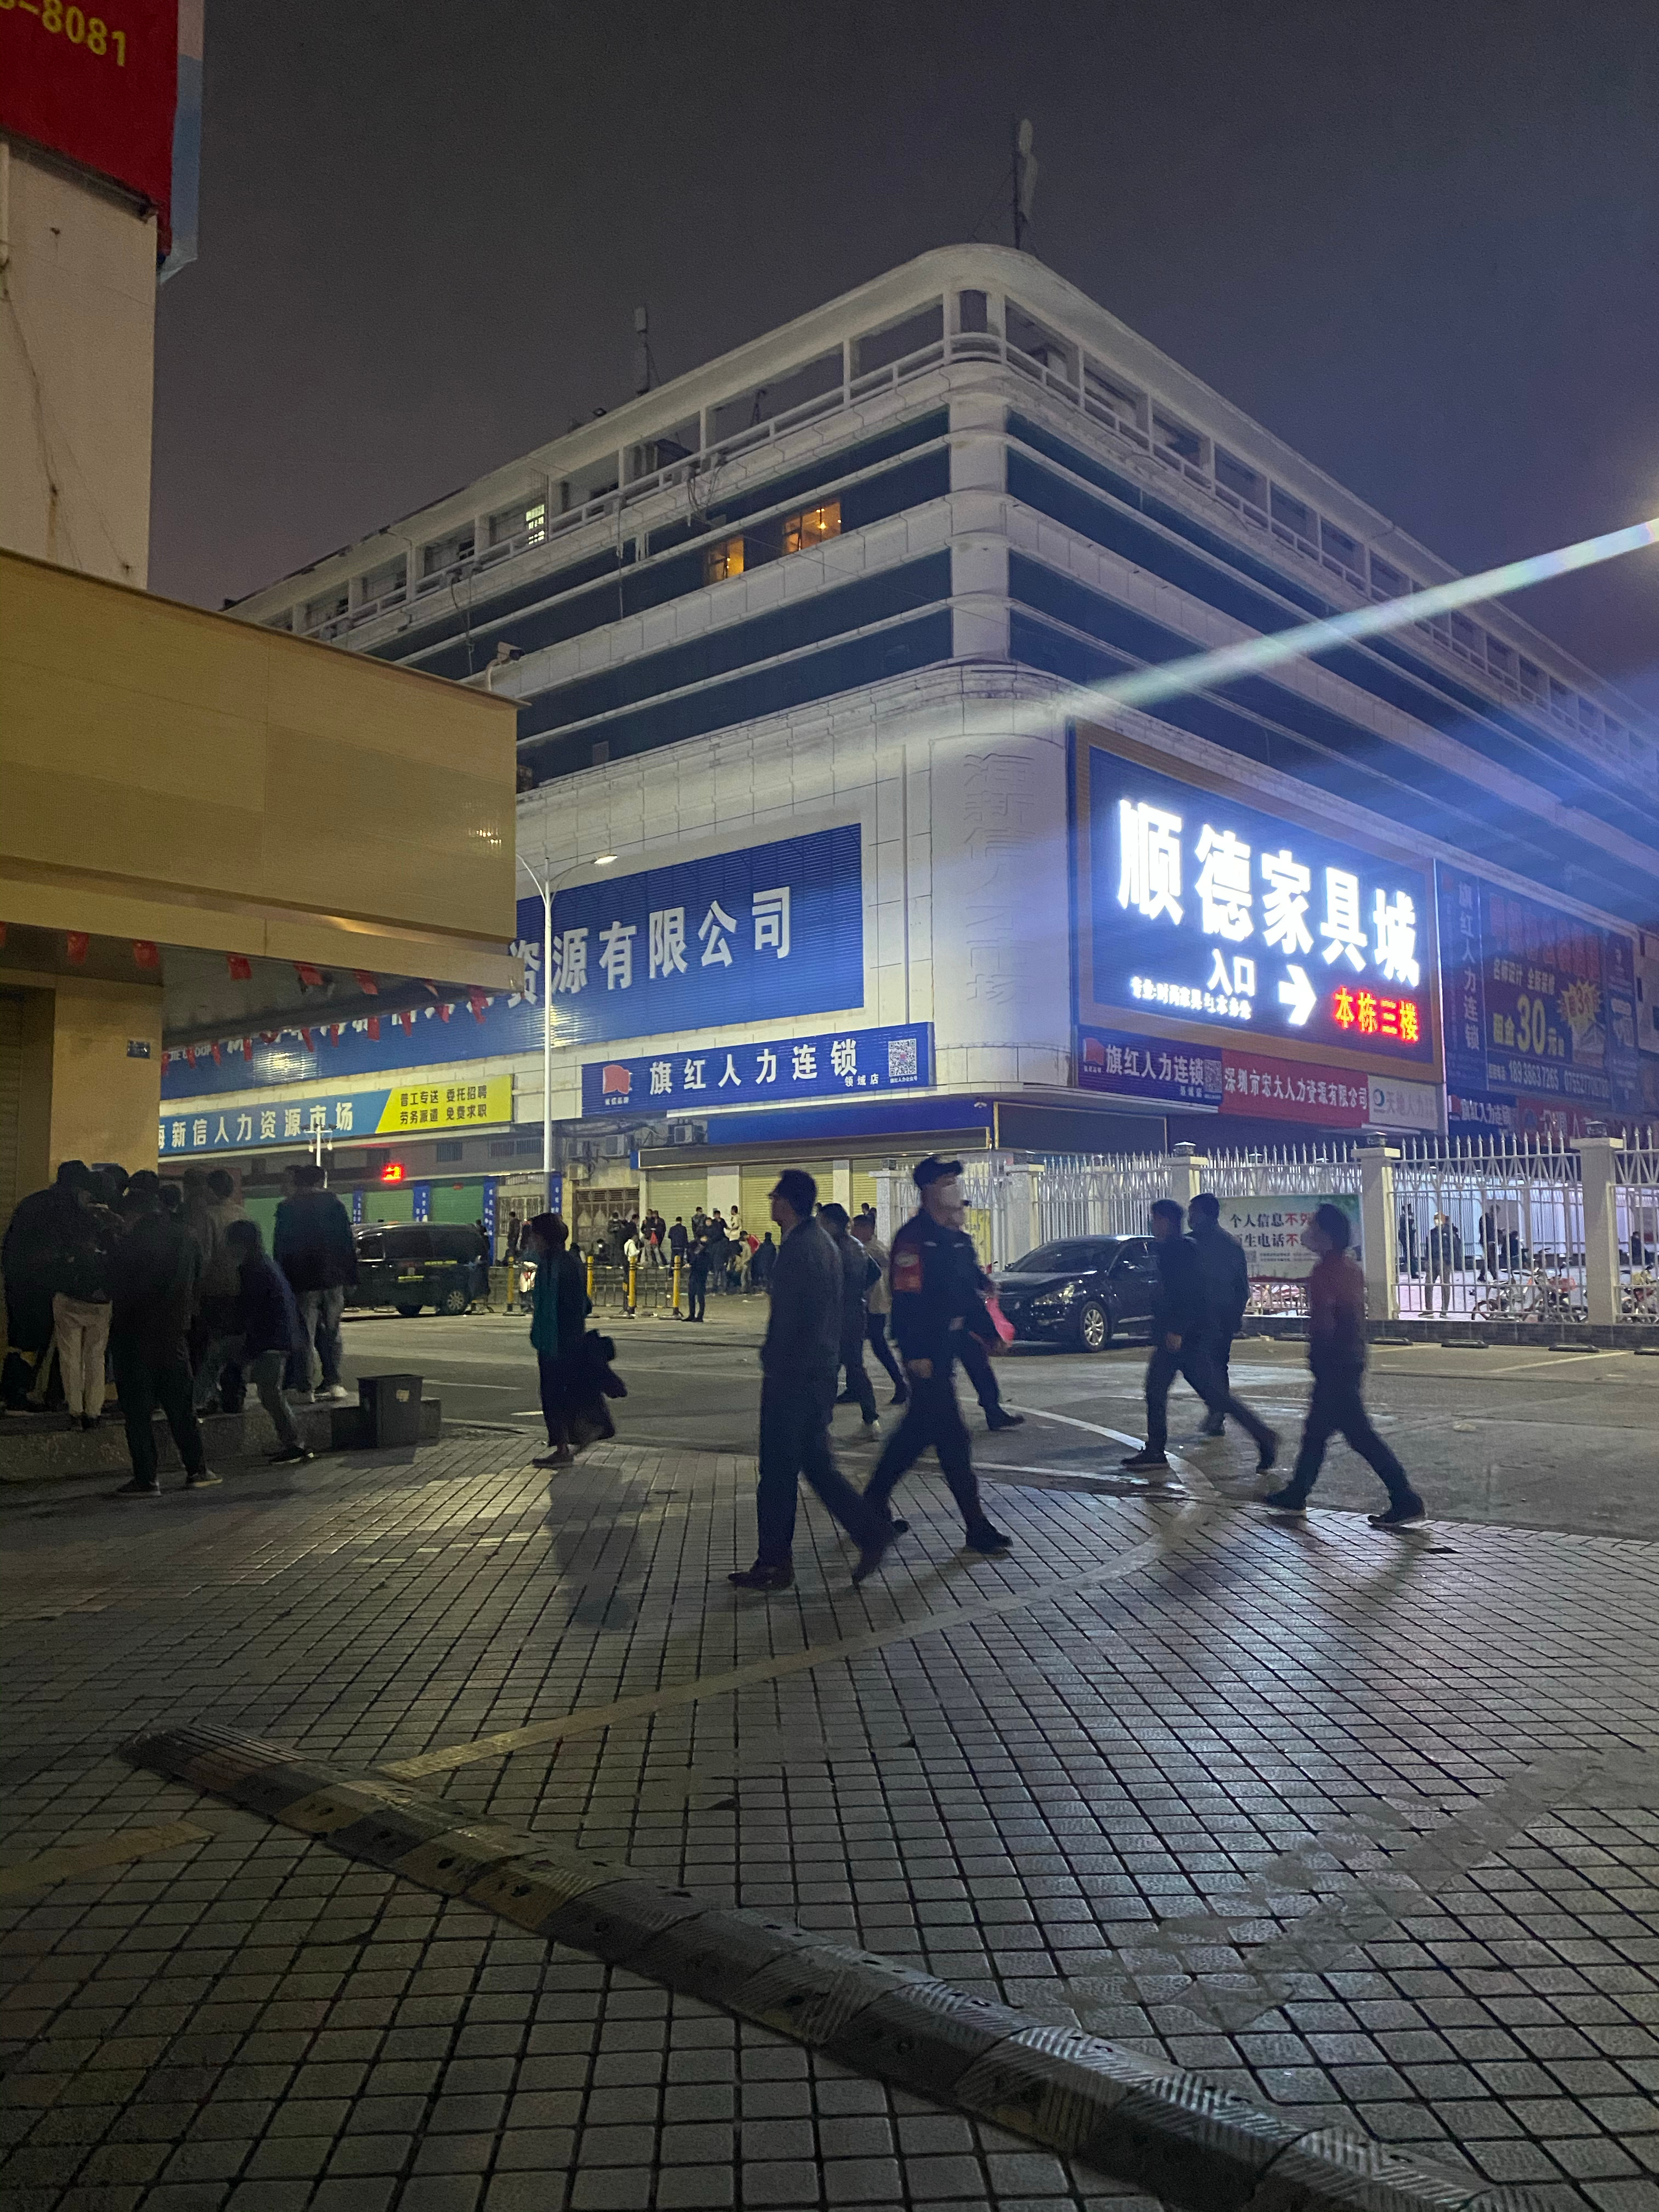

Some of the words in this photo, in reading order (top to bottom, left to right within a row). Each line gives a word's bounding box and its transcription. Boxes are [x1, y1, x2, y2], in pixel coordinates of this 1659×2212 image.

[1117, 799, 1421, 987] 顺德家具城
[1207, 948, 1256, 997] 入口
[1334, 986, 1419, 1042] 本栋三楼
[650, 1039, 857, 1096] 旗红人力连锁
[845, 1073, 879, 1087] 领域店
[1105, 1044, 1204, 1086] 旗红人力连锁
[1224, 1067, 1368, 1110] 深圳市宏大人力资源有限公司
[1234, 1232, 1300, 1248] 生电话不
